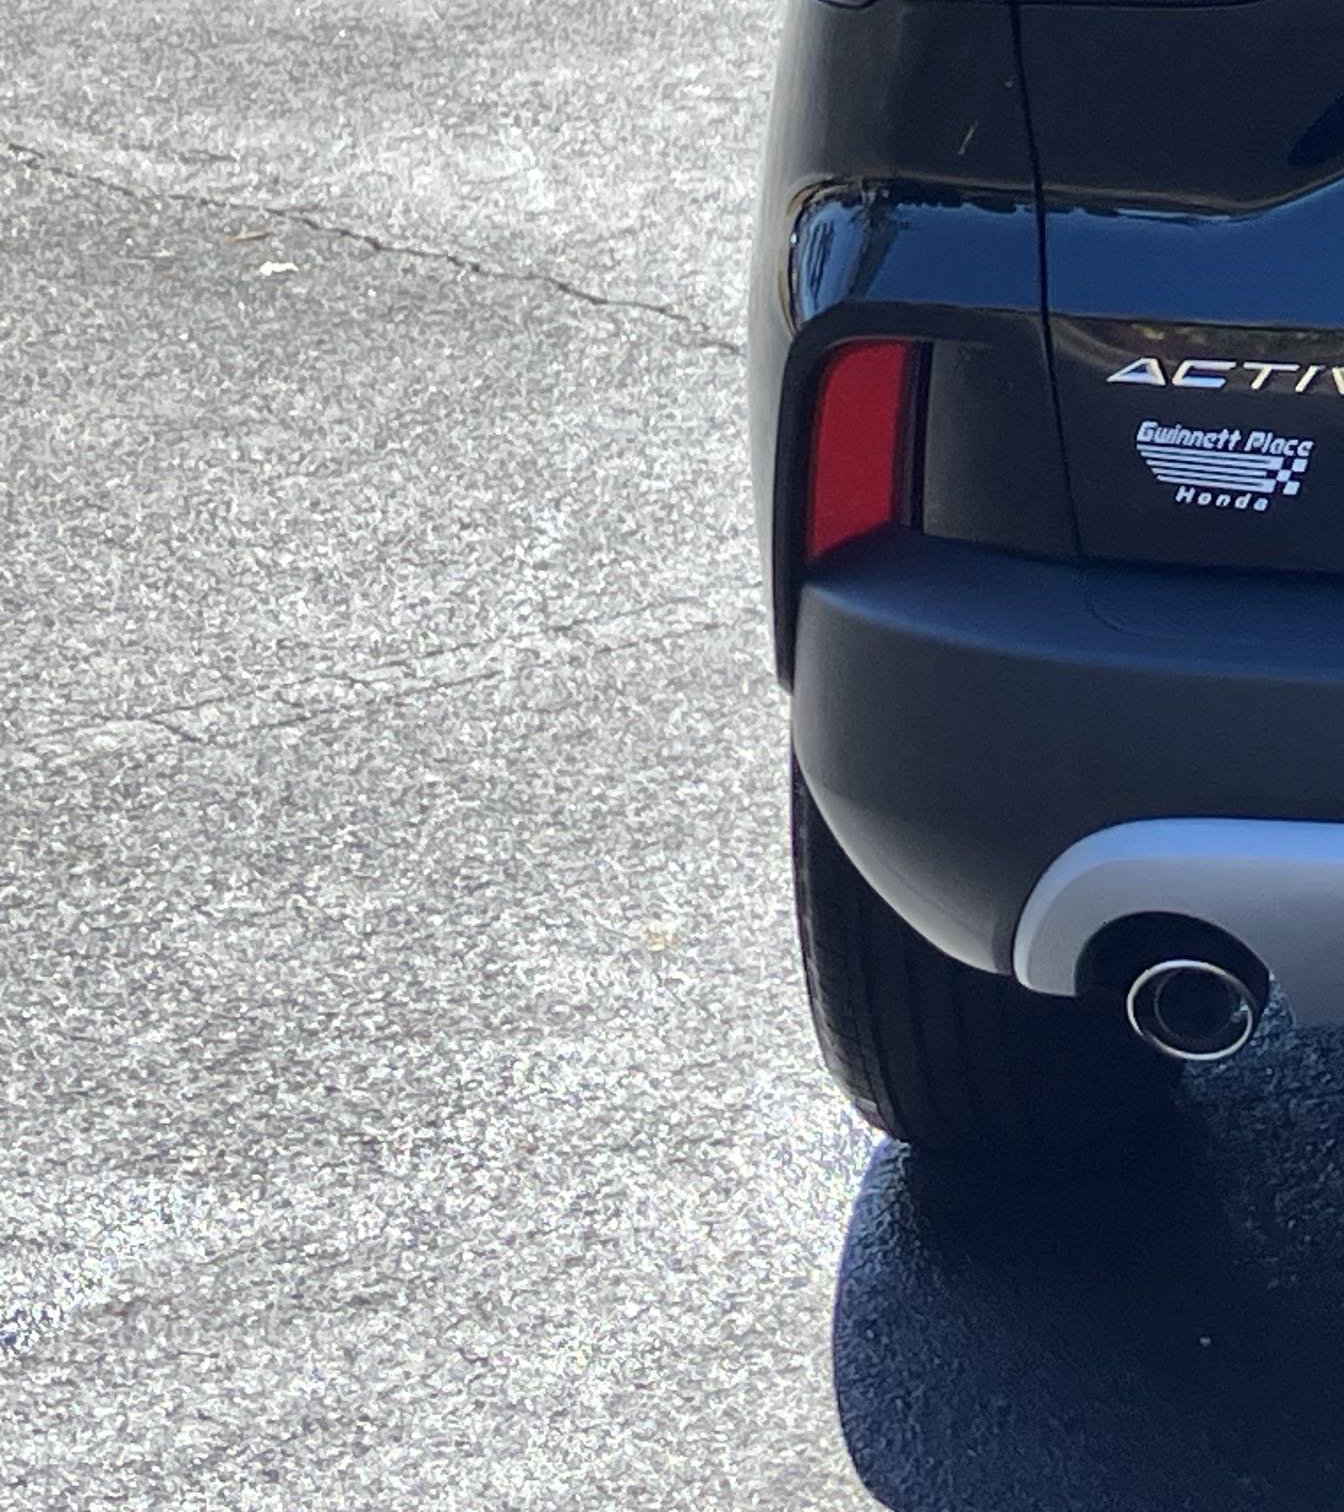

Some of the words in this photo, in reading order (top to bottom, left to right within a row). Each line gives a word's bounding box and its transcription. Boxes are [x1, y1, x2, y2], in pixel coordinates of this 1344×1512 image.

[1136, 421, 1242, 451] Gwinnett
[1244, 431, 1314, 457] Place
[1175, 485, 1269, 511] Honda
